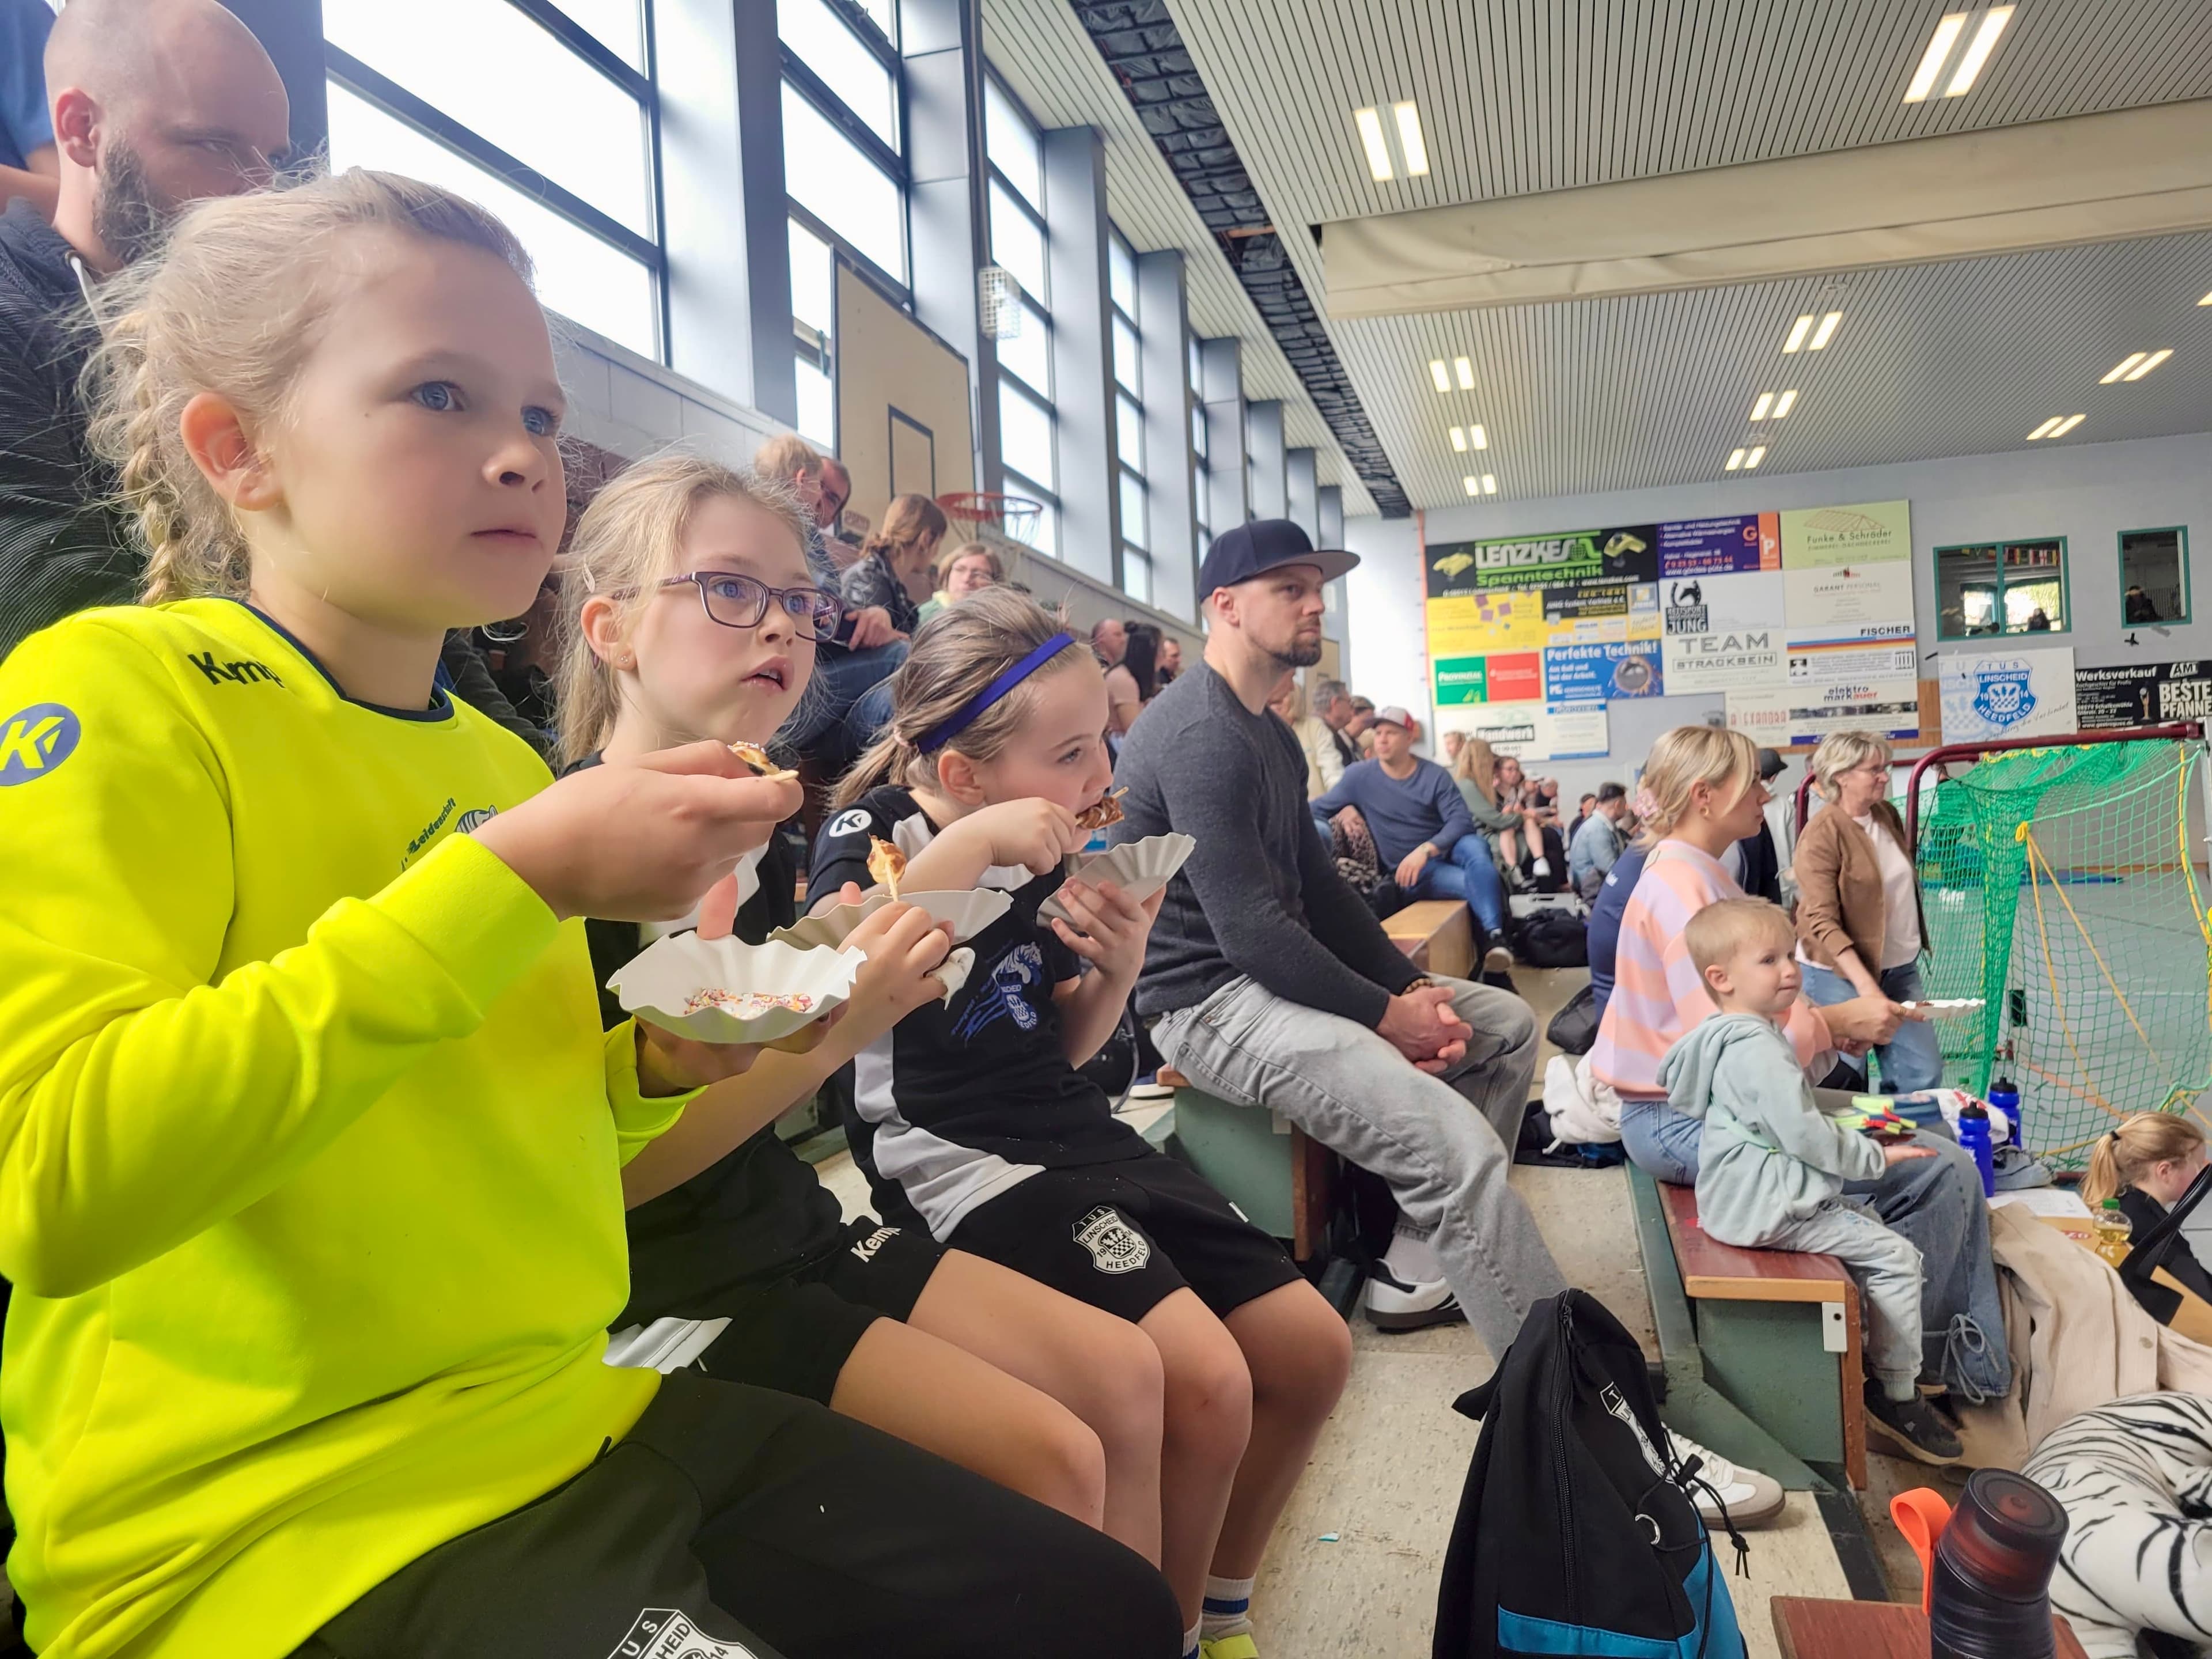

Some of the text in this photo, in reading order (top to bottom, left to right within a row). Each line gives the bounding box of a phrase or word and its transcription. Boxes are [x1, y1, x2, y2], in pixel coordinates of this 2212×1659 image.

[1807, 529, 1892, 544] Funke & Schröder
[1476, 566, 1603, 587] Spanntechnik
[1668, 618, 1706, 634] JUNG
[1861, 626, 1910, 637] FISCHER
[1547, 641, 1657, 661] Perfekte Technik!
[1679, 632, 1769, 654] TEAM
[1677, 655, 1773, 670] STRACKBEIN
[1979, 672, 2028, 683] LINSCHEID
[2075, 665, 2157, 682] Werksverkauf
[1824, 691, 1878, 702] markauer
[1828, 685, 1869, 695] elektro
[2159, 680, 2212, 703] BESTE
[1730, 710, 1787, 725] AEXANDRA
[1978, 704, 2031, 722] HEEDFELD
[2160, 700, 2212, 719] PFANNE
[1078, 1209, 1105, 1227] TUS
[1082, 1215, 1119, 1244] LINSCHEID
[1096, 1247, 1107, 1258] 19
[1106, 1240, 1146, 1268] HEEDFELD
